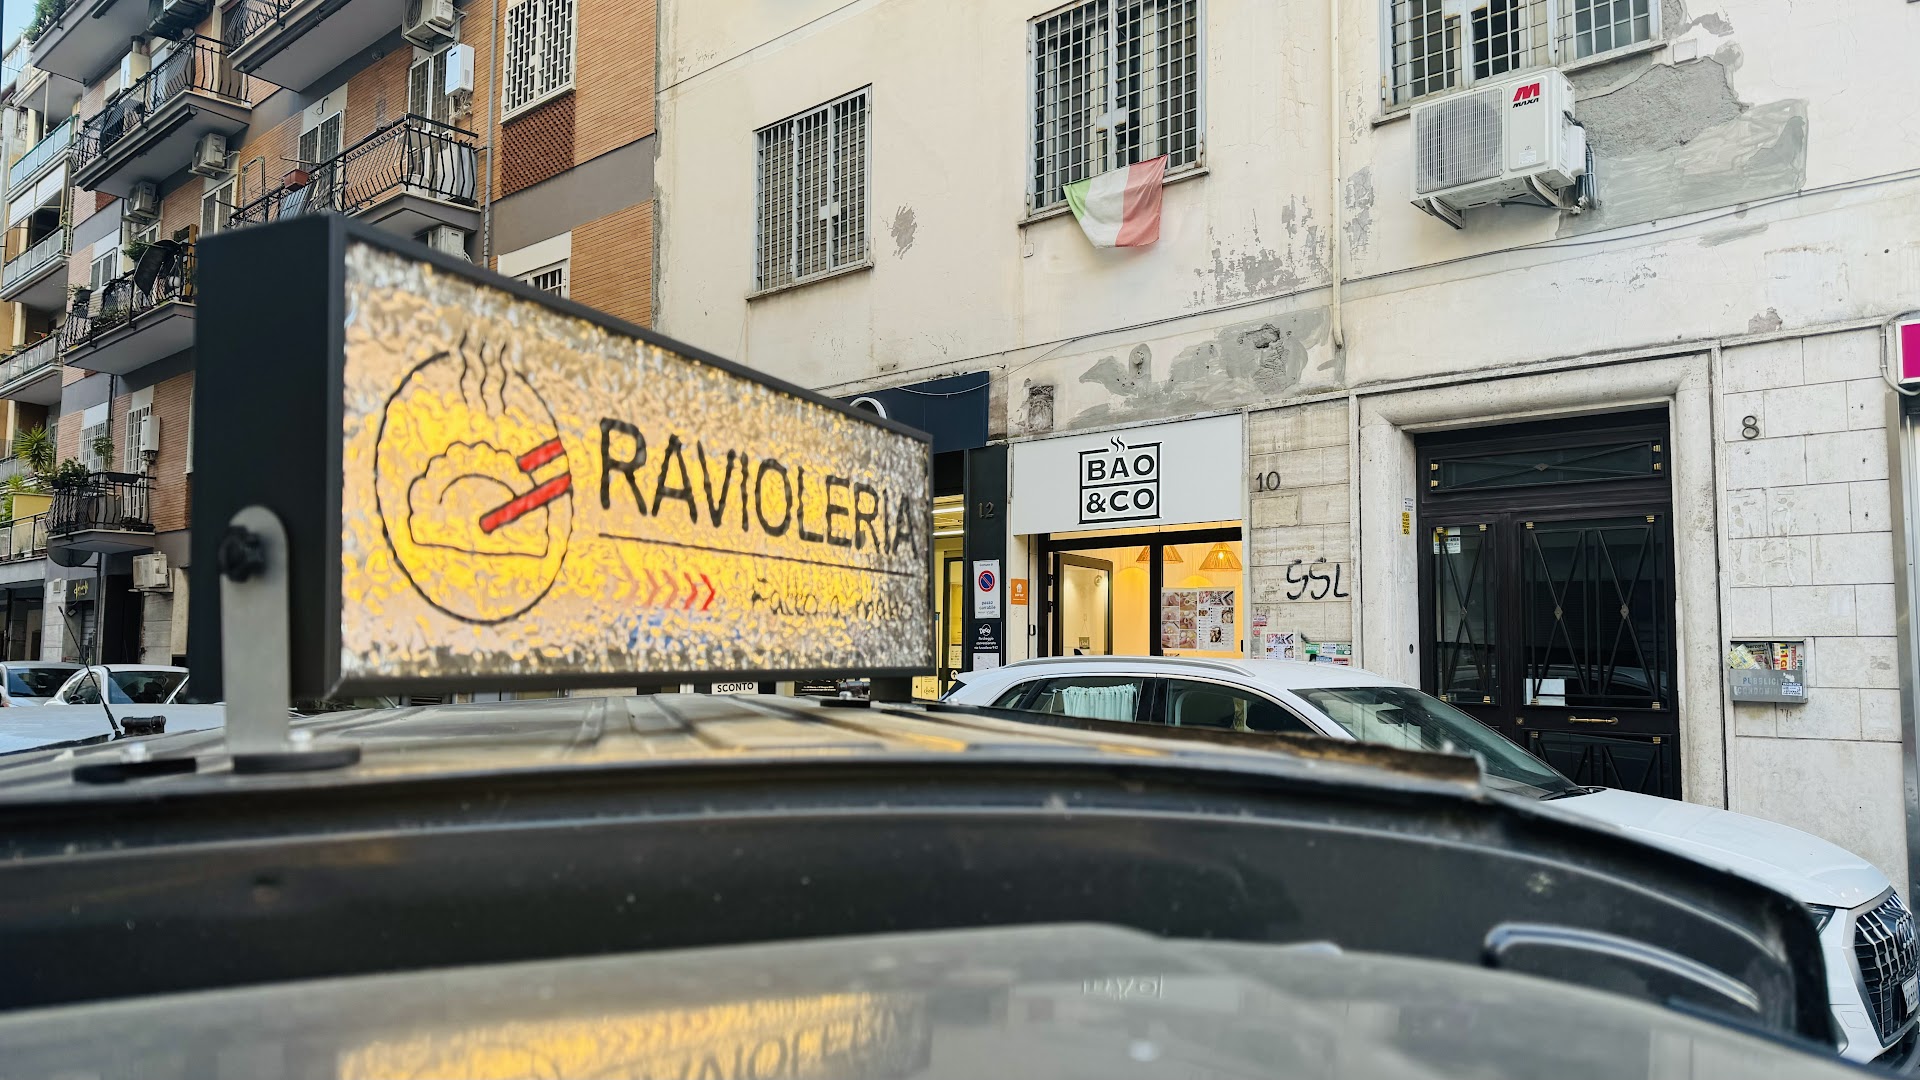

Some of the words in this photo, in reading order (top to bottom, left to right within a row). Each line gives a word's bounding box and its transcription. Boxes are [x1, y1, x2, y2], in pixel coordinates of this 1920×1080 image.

[1742, 415, 1760, 440] 8
[1087, 454, 1155, 482] BAO
[599, 416, 919, 559] RAVIOLERIA
[1255, 471, 1281, 493] 10
[978, 501, 995, 519] 12
[1086, 488, 1155, 514] &CO
[717, 682, 754, 693] SCONTO
